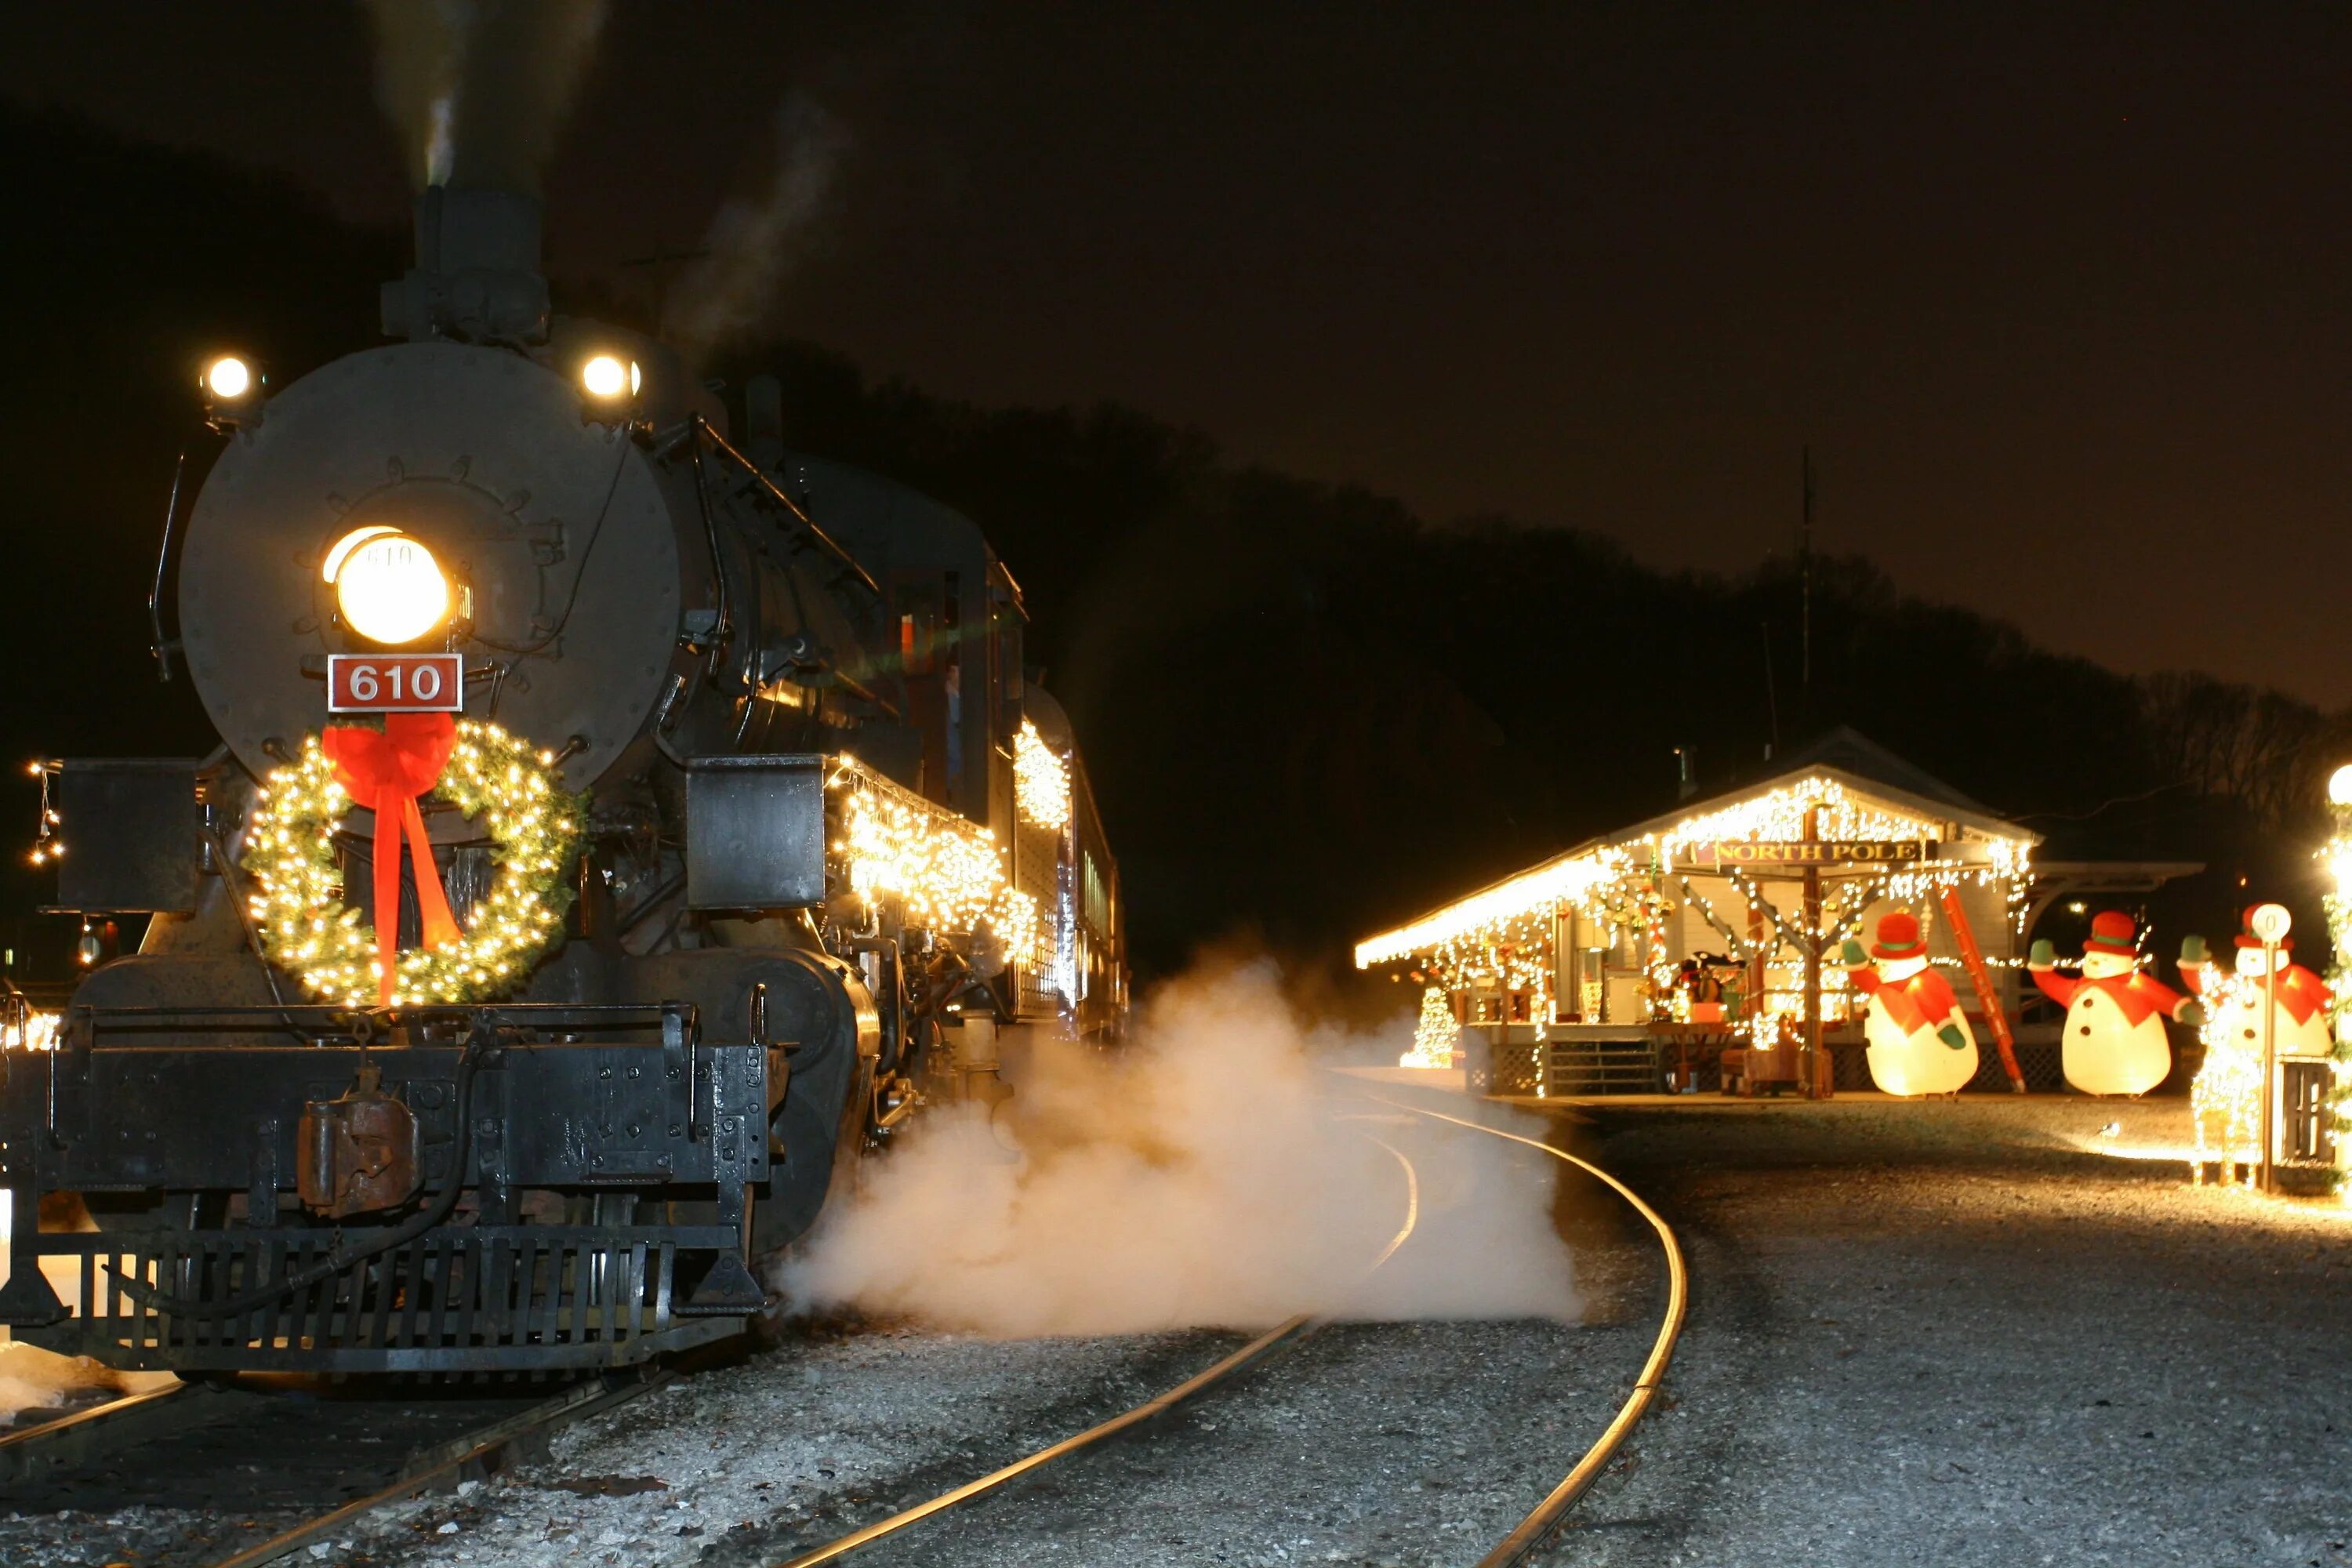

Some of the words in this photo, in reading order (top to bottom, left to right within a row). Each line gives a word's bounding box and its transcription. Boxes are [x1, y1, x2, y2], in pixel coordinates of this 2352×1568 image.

[350, 664, 441, 701] 610
[1712, 844, 1824, 861] NORTH
[1832, 844, 1916, 861] POLE
